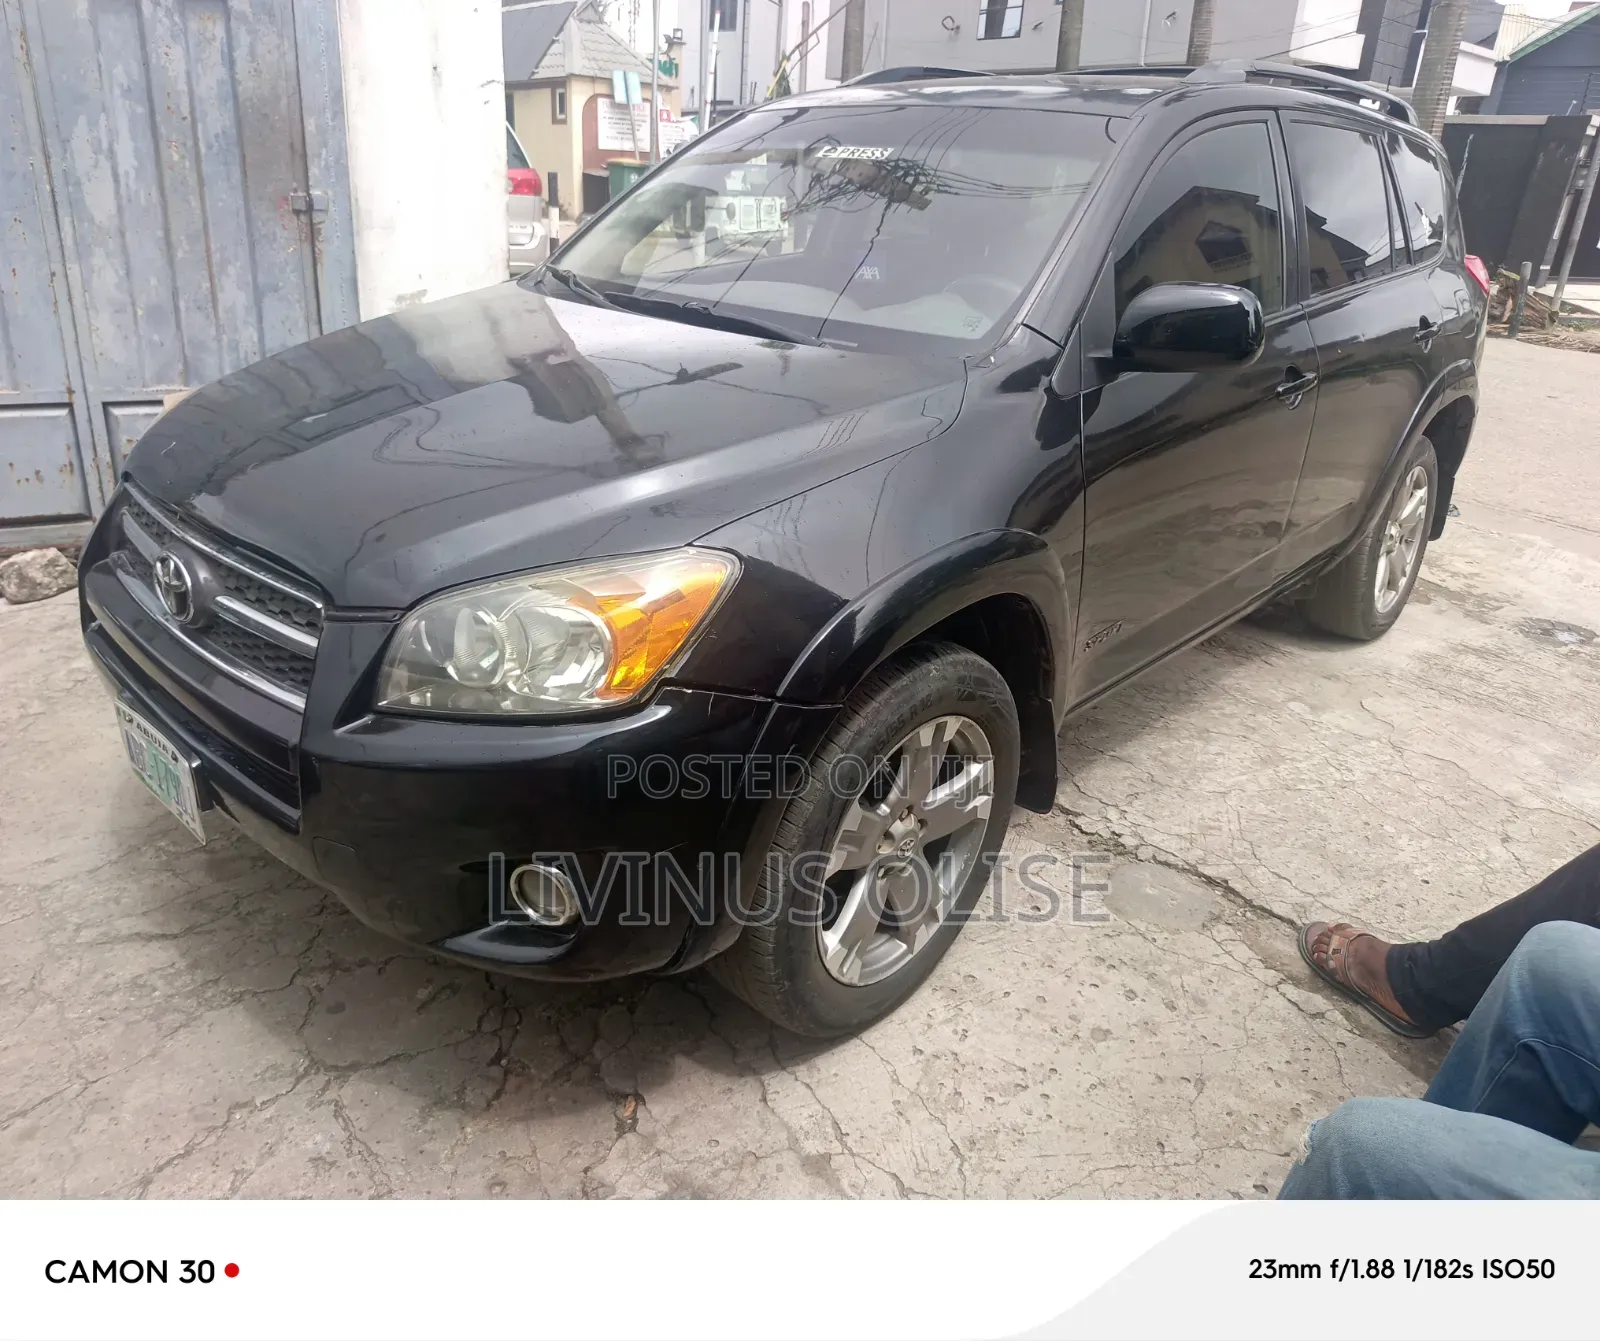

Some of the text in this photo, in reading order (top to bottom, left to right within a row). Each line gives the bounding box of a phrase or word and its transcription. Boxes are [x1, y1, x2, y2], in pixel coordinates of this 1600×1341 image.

[837, 148, 888, 159] PRESS
[855, 266, 880, 280] AXA
[136, 722, 169, 755] ABUJA
